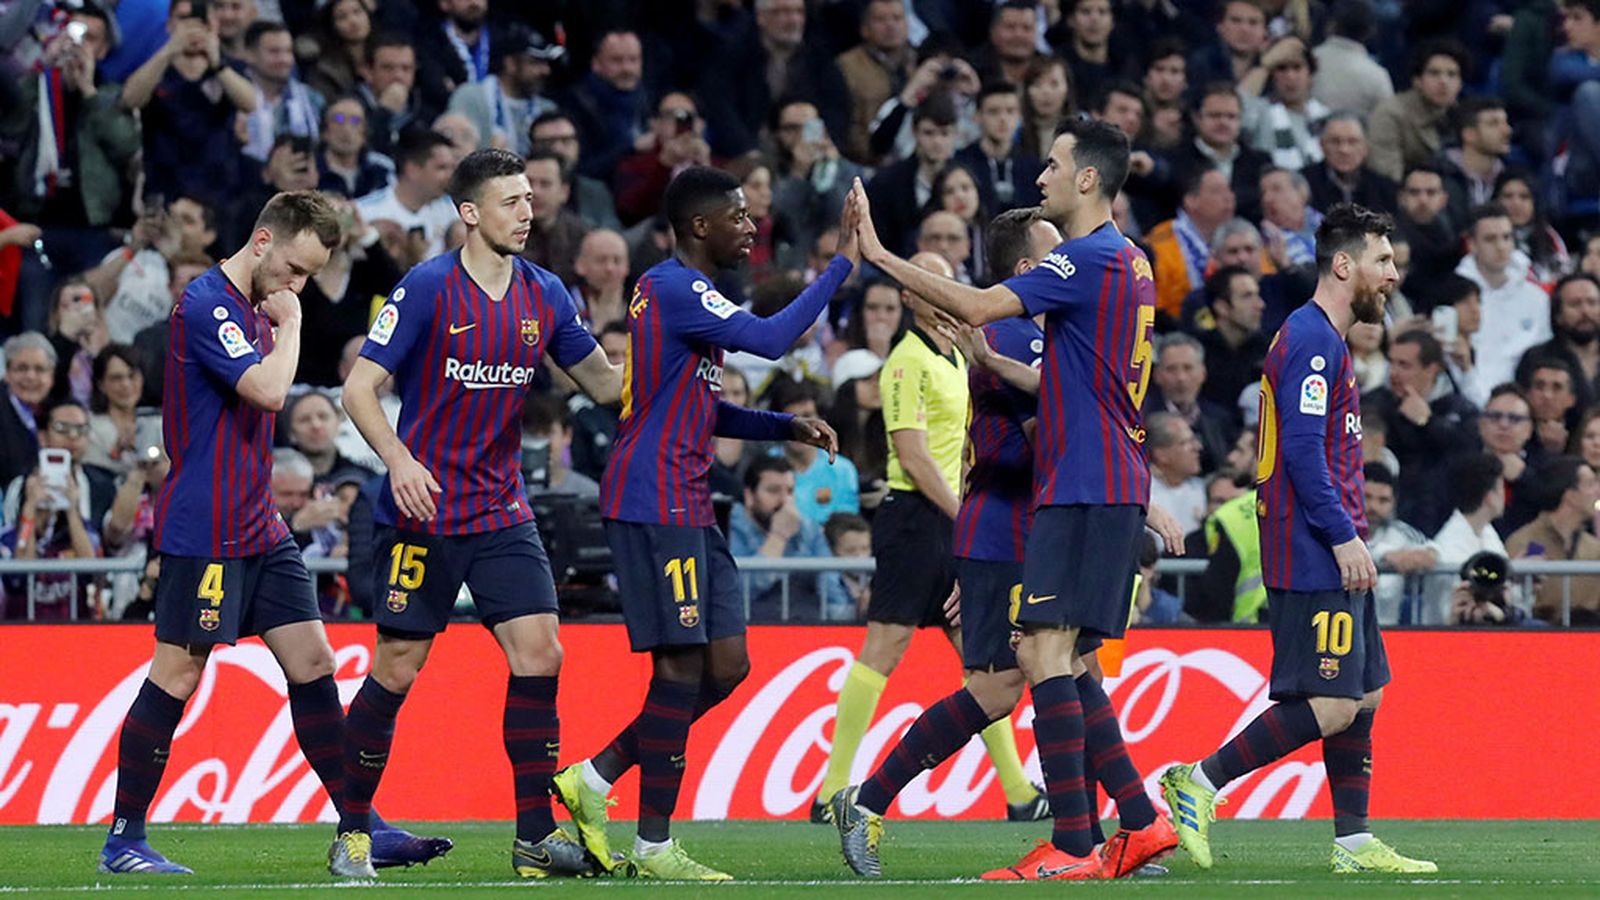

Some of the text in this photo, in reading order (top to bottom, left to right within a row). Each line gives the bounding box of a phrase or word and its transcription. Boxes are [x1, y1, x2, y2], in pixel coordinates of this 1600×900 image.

[445, 357, 535, 385] Rakuten
[197, 562, 225, 608] 4
[387, 542, 429, 591] 15
[663, 556, 699, 603] 11
[1311, 610, 1354, 656] 10
